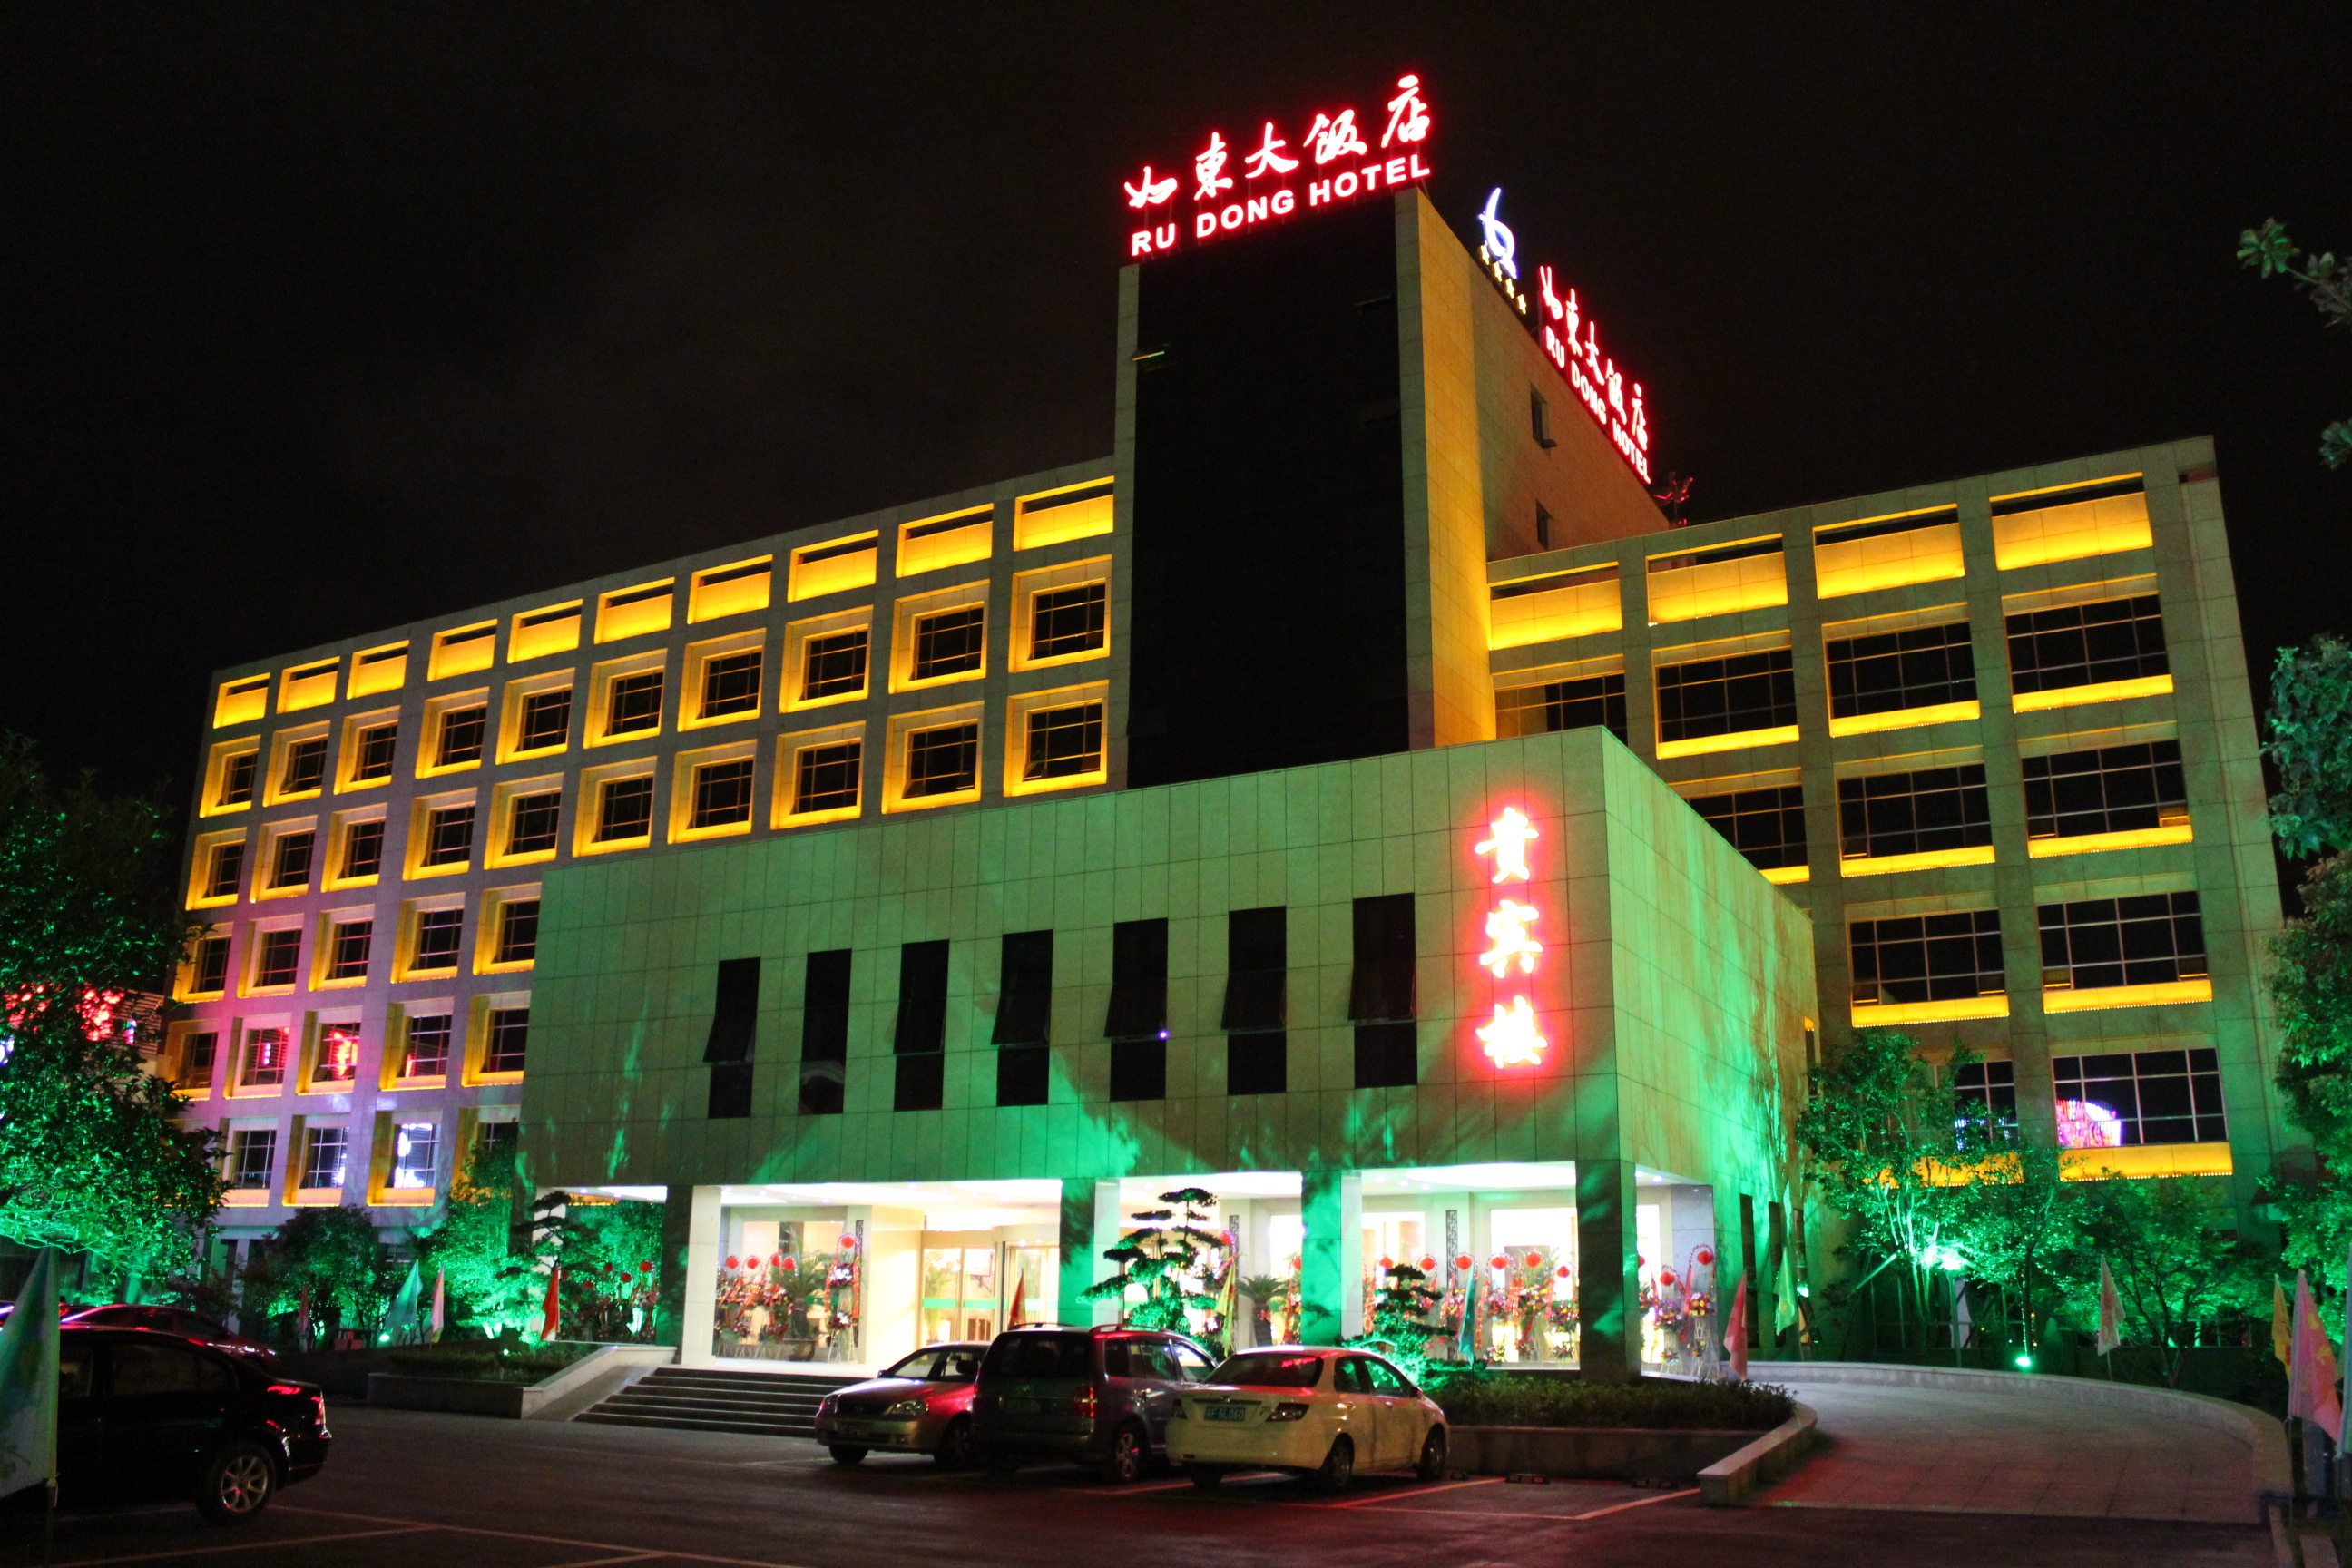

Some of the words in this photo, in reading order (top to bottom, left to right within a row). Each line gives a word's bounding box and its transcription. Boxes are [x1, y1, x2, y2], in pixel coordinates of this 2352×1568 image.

[1131, 222, 1176, 257] RU
[1195, 189, 1295, 239] DONG
[1308, 153, 1431, 208] HOTEL
[1544, 325, 1565, 369] RU
[1570, 359, 1607, 426] DONG
[1612, 417, 1651, 485] HOTEL
